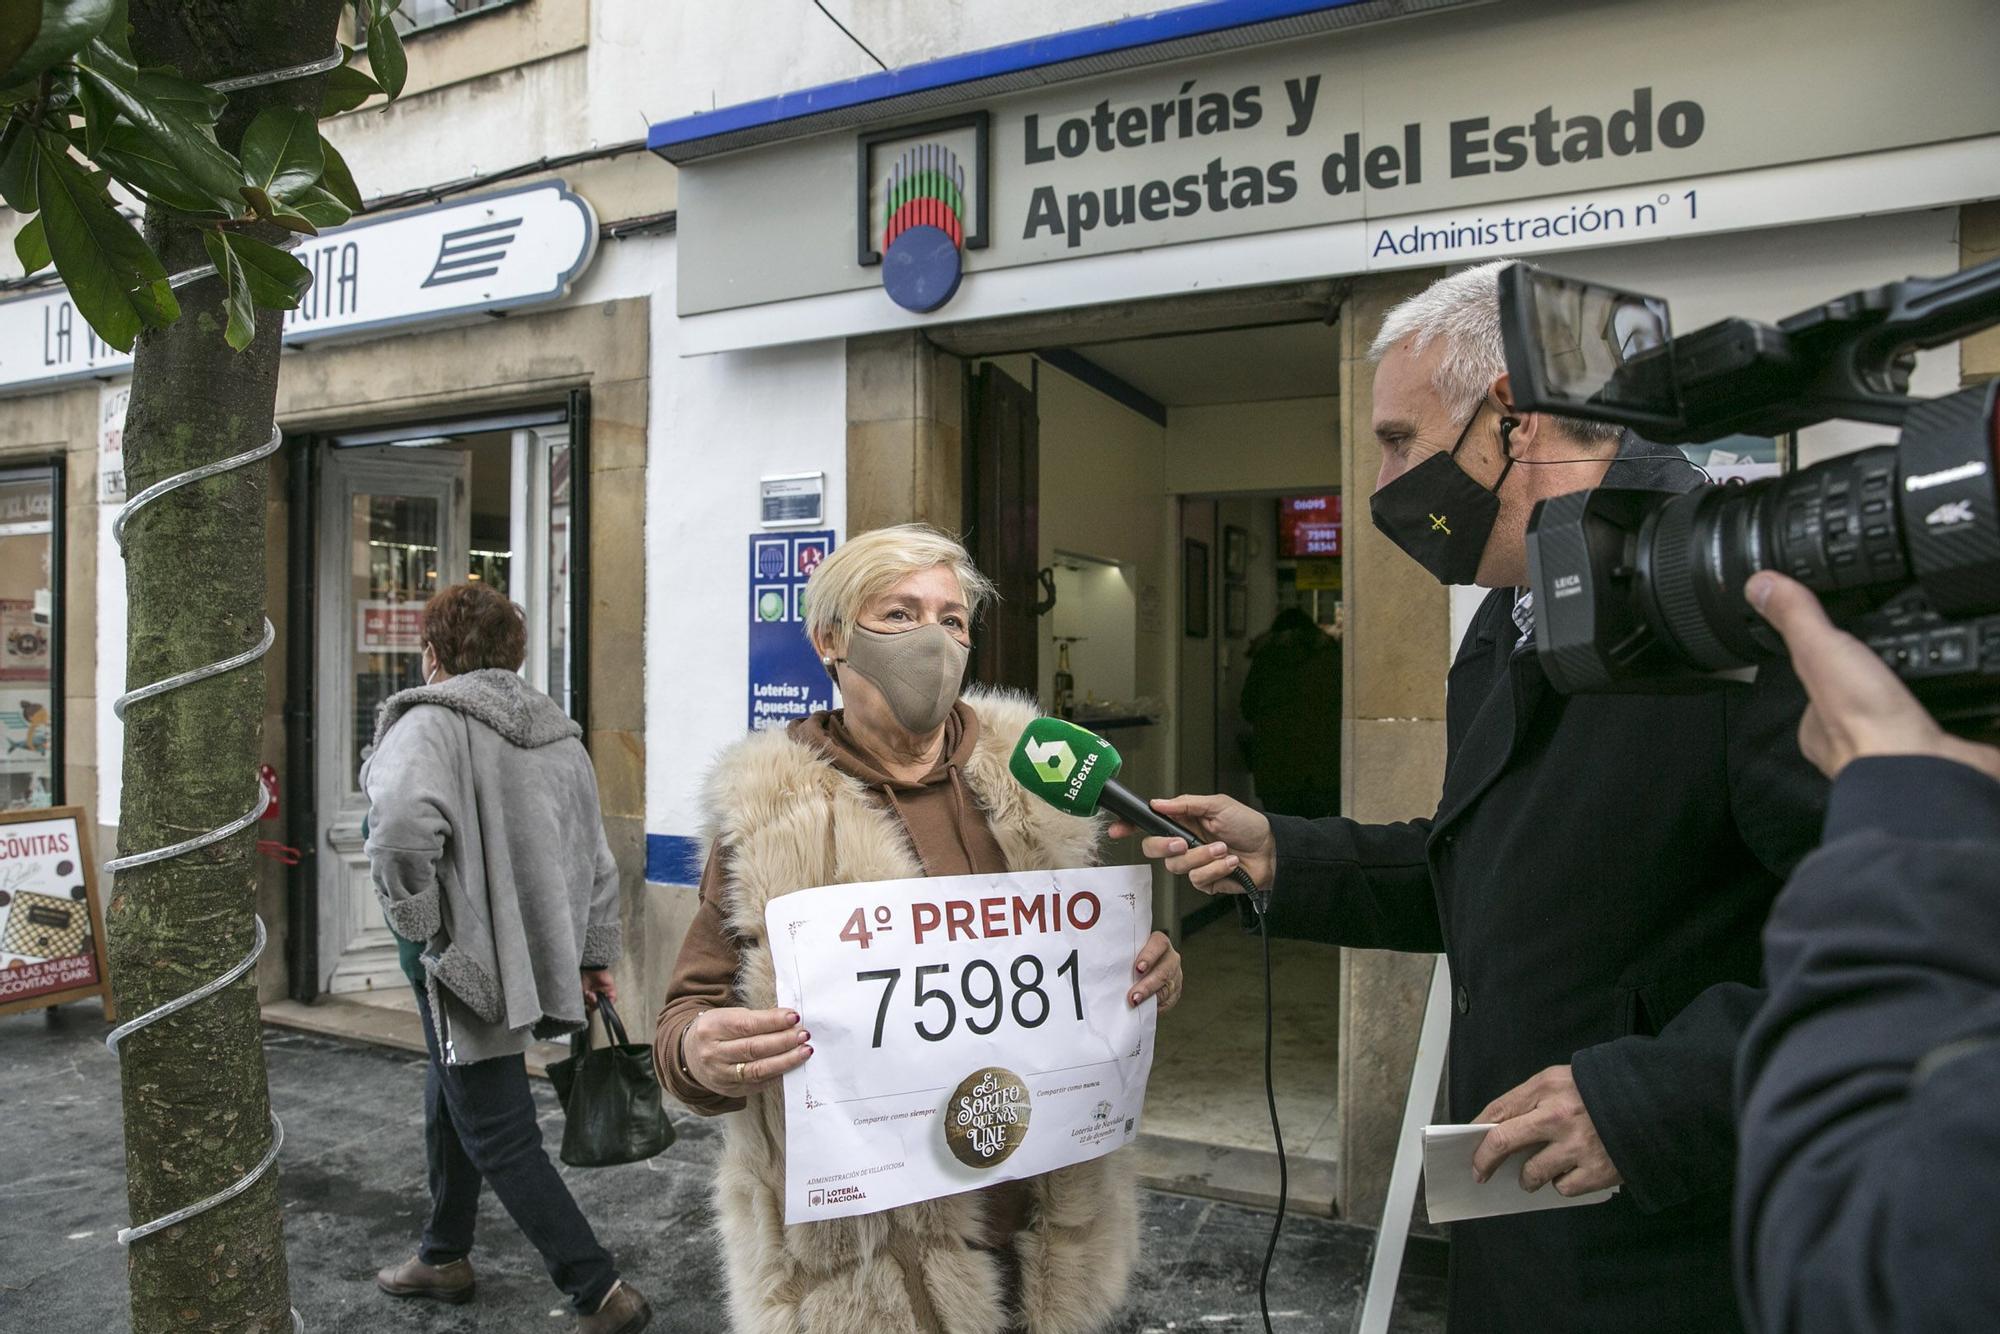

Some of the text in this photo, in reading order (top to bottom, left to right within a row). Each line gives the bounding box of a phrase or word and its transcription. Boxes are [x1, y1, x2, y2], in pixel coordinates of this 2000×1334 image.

[1024, 74, 1322, 166] Loterías y
[1022, 86, 1705, 249] Apuestas del Estado
[1372, 203, 1625, 258] Administración
[1683, 190, 1699, 220] 1
[44, 301, 73, 366] LA
[753, 683, 810, 701] Loterías y
[753, 700, 806, 717] Apuestas
[1063, 752, 1099, 801] laSexta
[911, 890, 1101, 944] PREMIO
[43, 955, 90, 974] NUEVAS
[856, 949, 1084, 1049] 75981
[1036, 1086, 1067, 1098] Compartir
[1066, 1083, 1083, 1092] como
[957, 1086, 1020, 1126] SORTEO
[972, 1105, 1019, 1129] QUE NOS
[853, 1115, 889, 1127] Compartir
[890, 1111, 909, 1121] como
[1071, 1124, 1094, 1138] Lotería
[1093, 1121, 1103, 1131] de
[966, 1124, 1008, 1158] UNE
[806, 1161, 906, 1186] ADMINISTRACIÓN DE VILLAVICIOSA
[826, 1185, 860, 1198] LOTERÍA
[826, 1191, 868, 1205] NACIONAL
